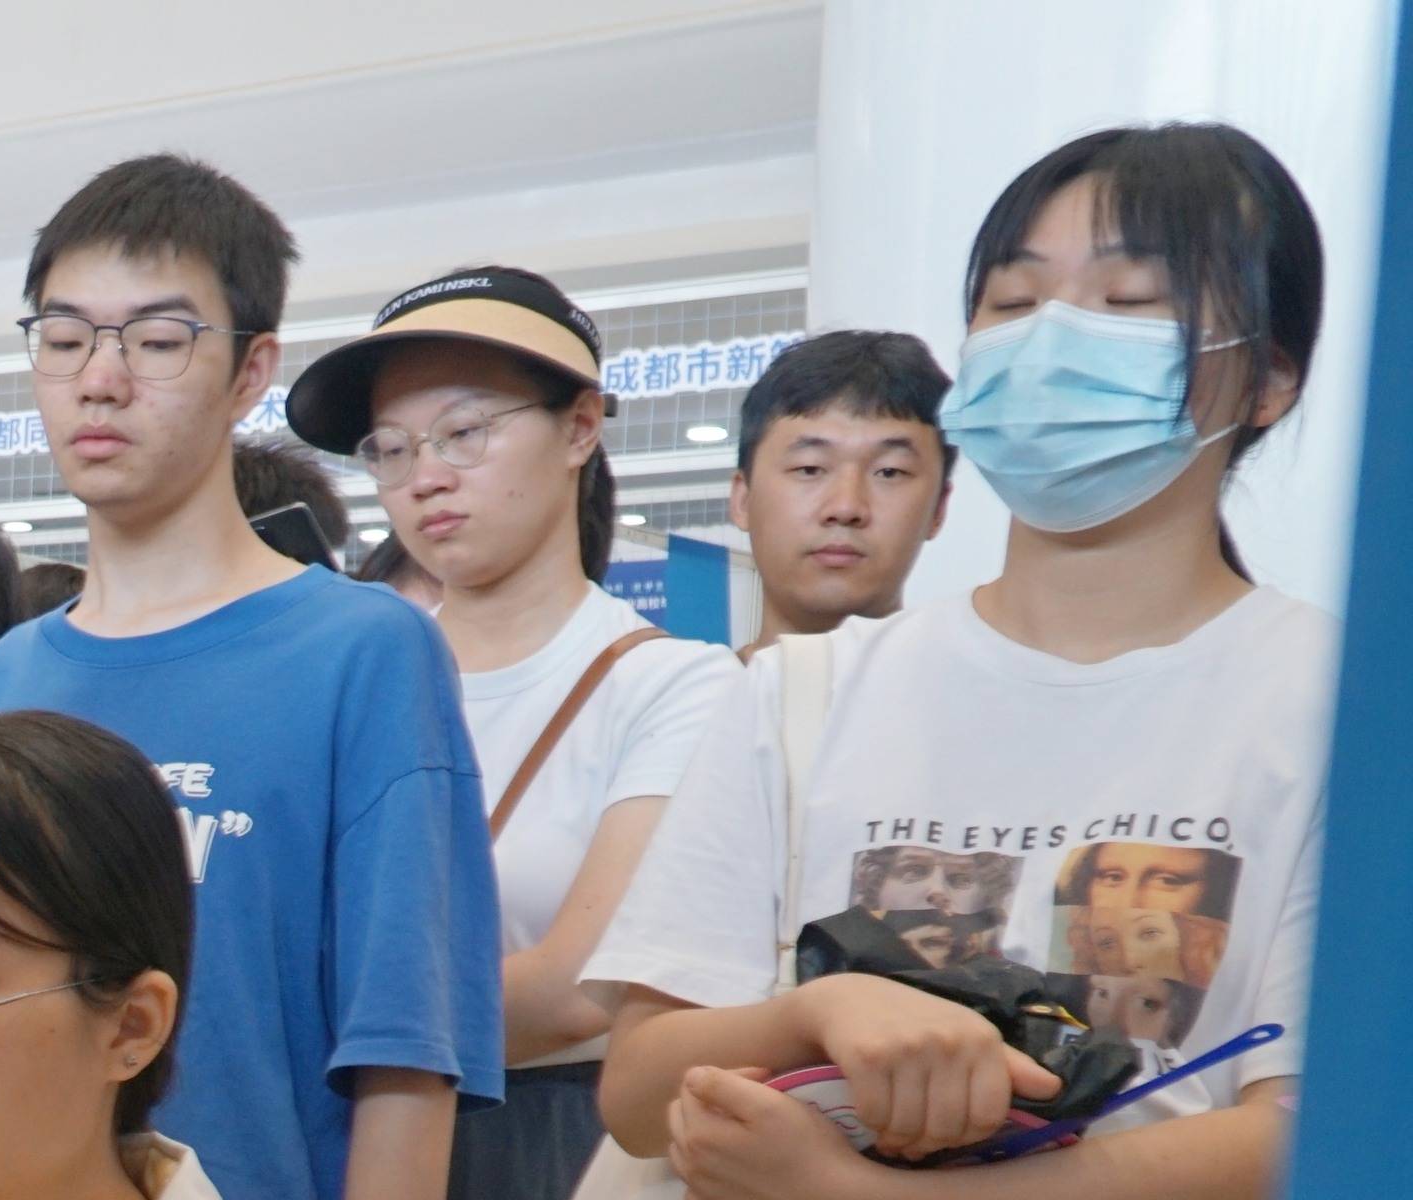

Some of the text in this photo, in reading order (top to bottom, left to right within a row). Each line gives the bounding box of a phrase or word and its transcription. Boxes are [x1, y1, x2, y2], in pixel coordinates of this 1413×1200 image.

[605, 334, 805, 394] 成都市新
[153, 763, 214, 797] FE
[866, 818, 943, 844] THE
[963, 825, 1067, 851] EYES
